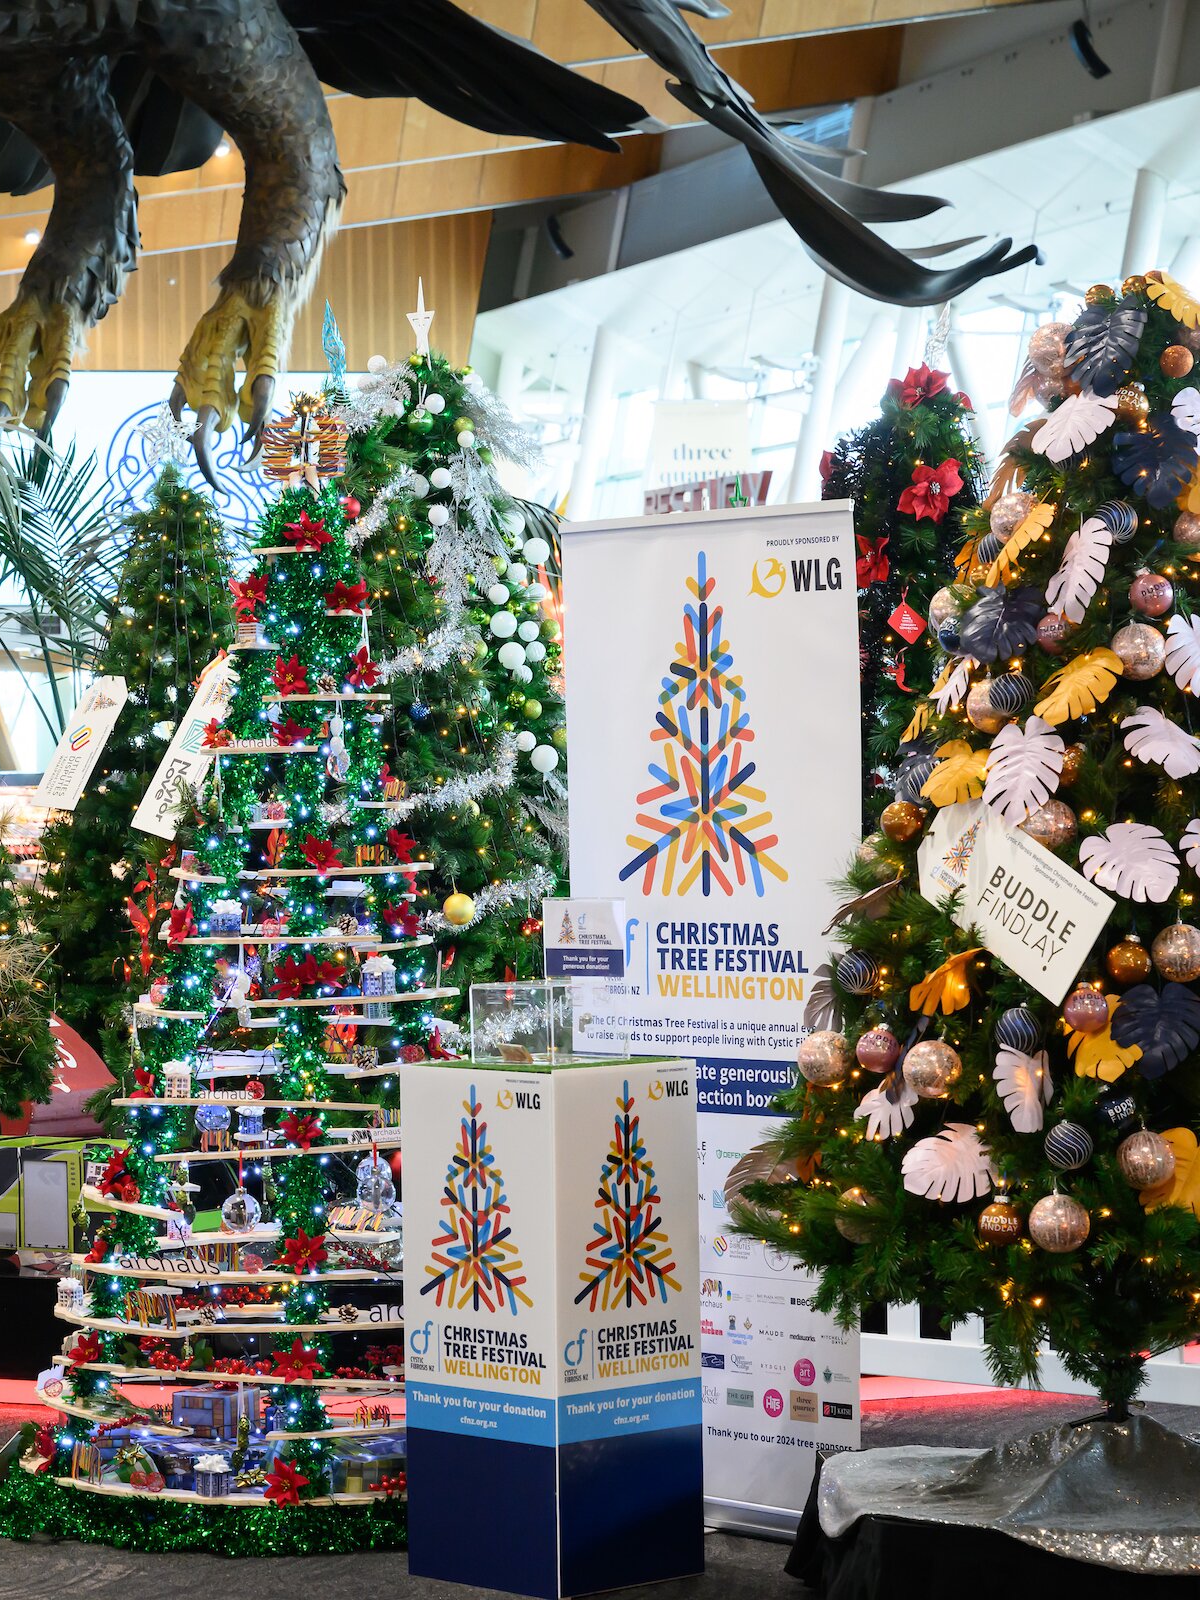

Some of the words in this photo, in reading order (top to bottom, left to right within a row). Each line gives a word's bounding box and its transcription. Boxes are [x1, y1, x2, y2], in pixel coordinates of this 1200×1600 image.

[673, 443, 731, 460] three
[766, 538, 794, 547] PROUDLY
[795, 537, 830, 546] SPONSORED
[791, 557, 842, 592] WLG
[154, 758, 180, 800] Love
[157, 761, 192, 823] Naylor
[1034, 864, 1055, 883] Sponsored
[1053, 869, 1074, 888] Christmas
[1082, 891, 1099, 906] Festival
[988, 865, 1076, 944] BUDDLE
[656, 922, 779, 946] CHRISTMAS
[977, 888, 1064, 964] FINDLAY
[657, 948, 708, 971] TREE
[714, 949, 809, 974] FESTIVAL
[631, 986, 640, 995] NZ
[657, 974, 804, 1001] WELLINGTON
[618, 1016, 663, 1027] Christmas
[665, 1018, 685, 1028] Tree
[687, 1018, 719, 1029] Festival
[721, 1019, 728, 1029] is
[729, 1022, 735, 1030] a
[737, 1020, 767, 1033] unique
[768, 1022, 798, 1032] annual
[596, 1030, 614, 1040] raise
[643, 1032, 653, 1041] to
[655, 1033, 690, 1045] support
[692, 1034, 720, 1046] people
[722, 1035, 745, 1047] living
[746, 1036, 766, 1046] with
[768, 1036, 794, 1049] Cystic
[720, 1065, 799, 1088] generously
[666, 1080, 689, 1097] WLG
[515, 1093, 541, 1110] WLG
[373, 1129, 401, 1137] archaus
[444, 1325, 528, 1349] CHRISTMAS
[598, 1319, 677, 1344] CHRISTMAS
[444, 1341, 477, 1360] TREE
[481, 1346, 547, 1369] FESTIVAL
[598, 1342, 630, 1361] TREE
[634, 1334, 695, 1355] FESTIVAL
[410, 1356, 424, 1364] CYSTIC
[410, 1363, 428, 1371] FIBROSIS
[598, 1352, 690, 1378] WELLINGTON
[444, 1359, 541, 1385] WELLINGTON
[564, 1375, 581, 1383] FIBROSIS
[800, 1368, 811, 1377] art
[412, 1391, 442, 1404] Thank
[443, 1395, 461, 1409] you
[463, 1396, 477, 1409] for
[479, 1400, 501, 1414] your
[503, 1403, 547, 1418] donation
[566, 1403, 595, 1416] Thank
[597, 1400, 615, 1413] you
[616, 1396, 630, 1409] for
[631, 1394, 654, 1407] your
[655, 1388, 695, 1402] donation
[796, 1396, 812, 1404] three
[460, 1416, 497, 1429] cfnz.org.nz
[614, 1414, 649, 1426] cfnz.org.nz
[707, 1426, 732, 1438] Thank
[733, 1431, 748, 1441] you
[750, 1432, 759, 1441] to
[760, 1435, 774, 1443] our
[776, 1435, 795, 1446] 2024
[797, 1438, 814, 1449] tree
